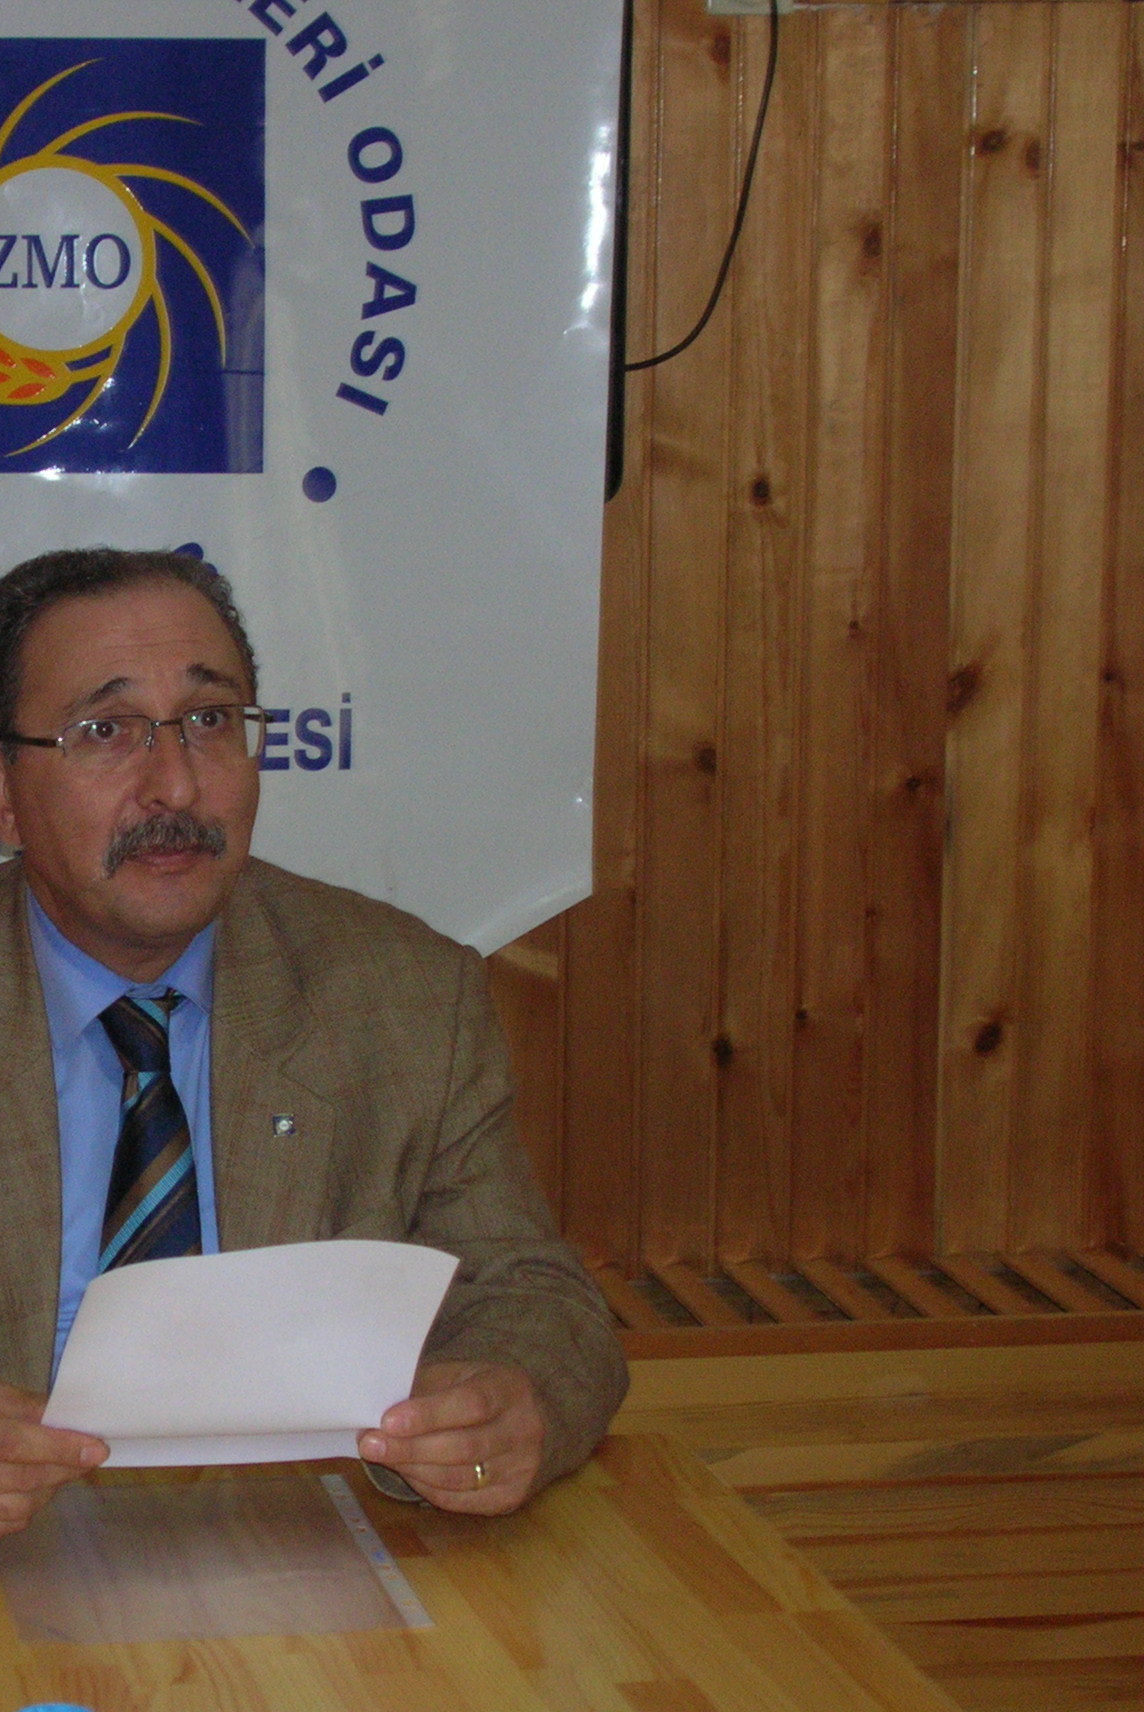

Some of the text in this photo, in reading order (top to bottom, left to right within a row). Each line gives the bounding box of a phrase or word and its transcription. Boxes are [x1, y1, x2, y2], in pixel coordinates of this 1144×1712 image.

[248, 0, 384, 103] ERİ
[336, 126, 417, 416] ODASI
[258, 692, 352, 771] ESİ
